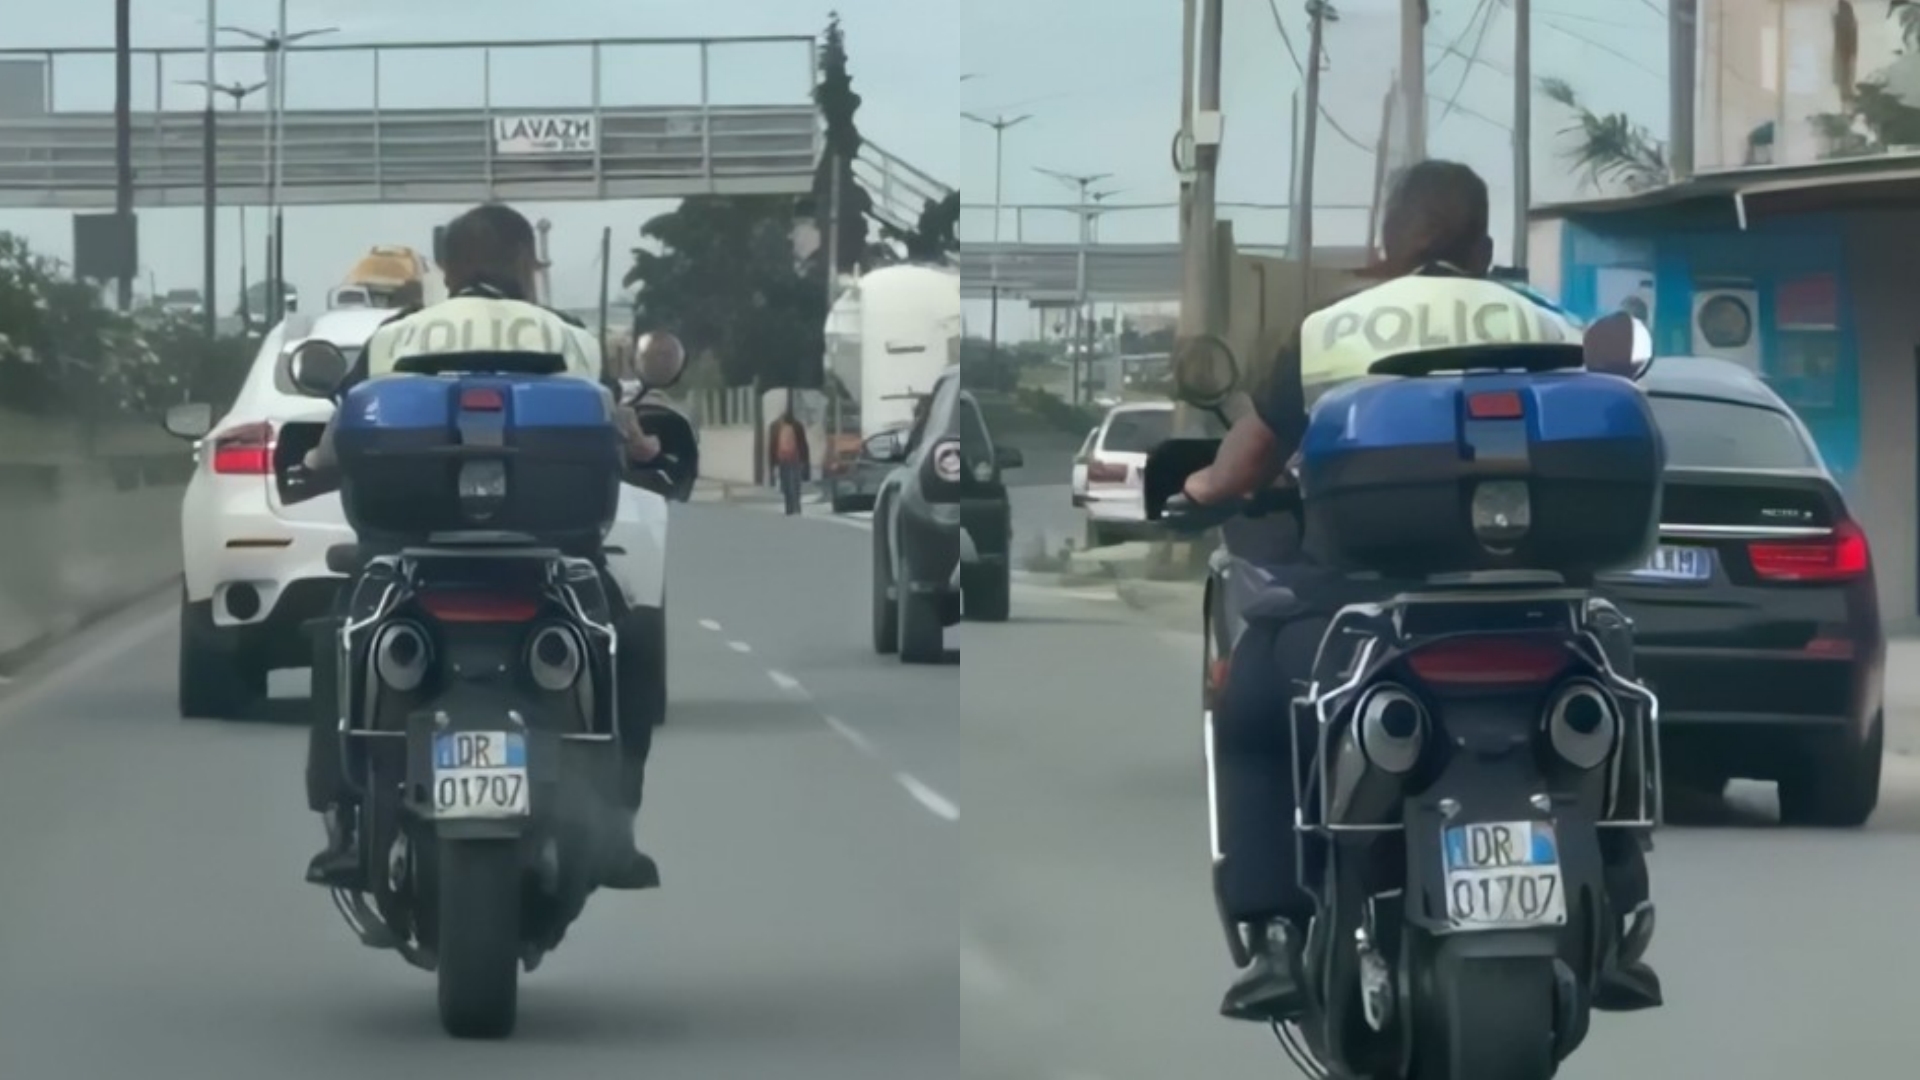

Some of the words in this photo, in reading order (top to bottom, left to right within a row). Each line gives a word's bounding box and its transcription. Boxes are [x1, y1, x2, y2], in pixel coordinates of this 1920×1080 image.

[457, 734, 492, 768] DR
[439, 773, 523, 807] 01707
[1471, 825, 1512, 866] DR
[1453, 873, 1556, 919] 01707
